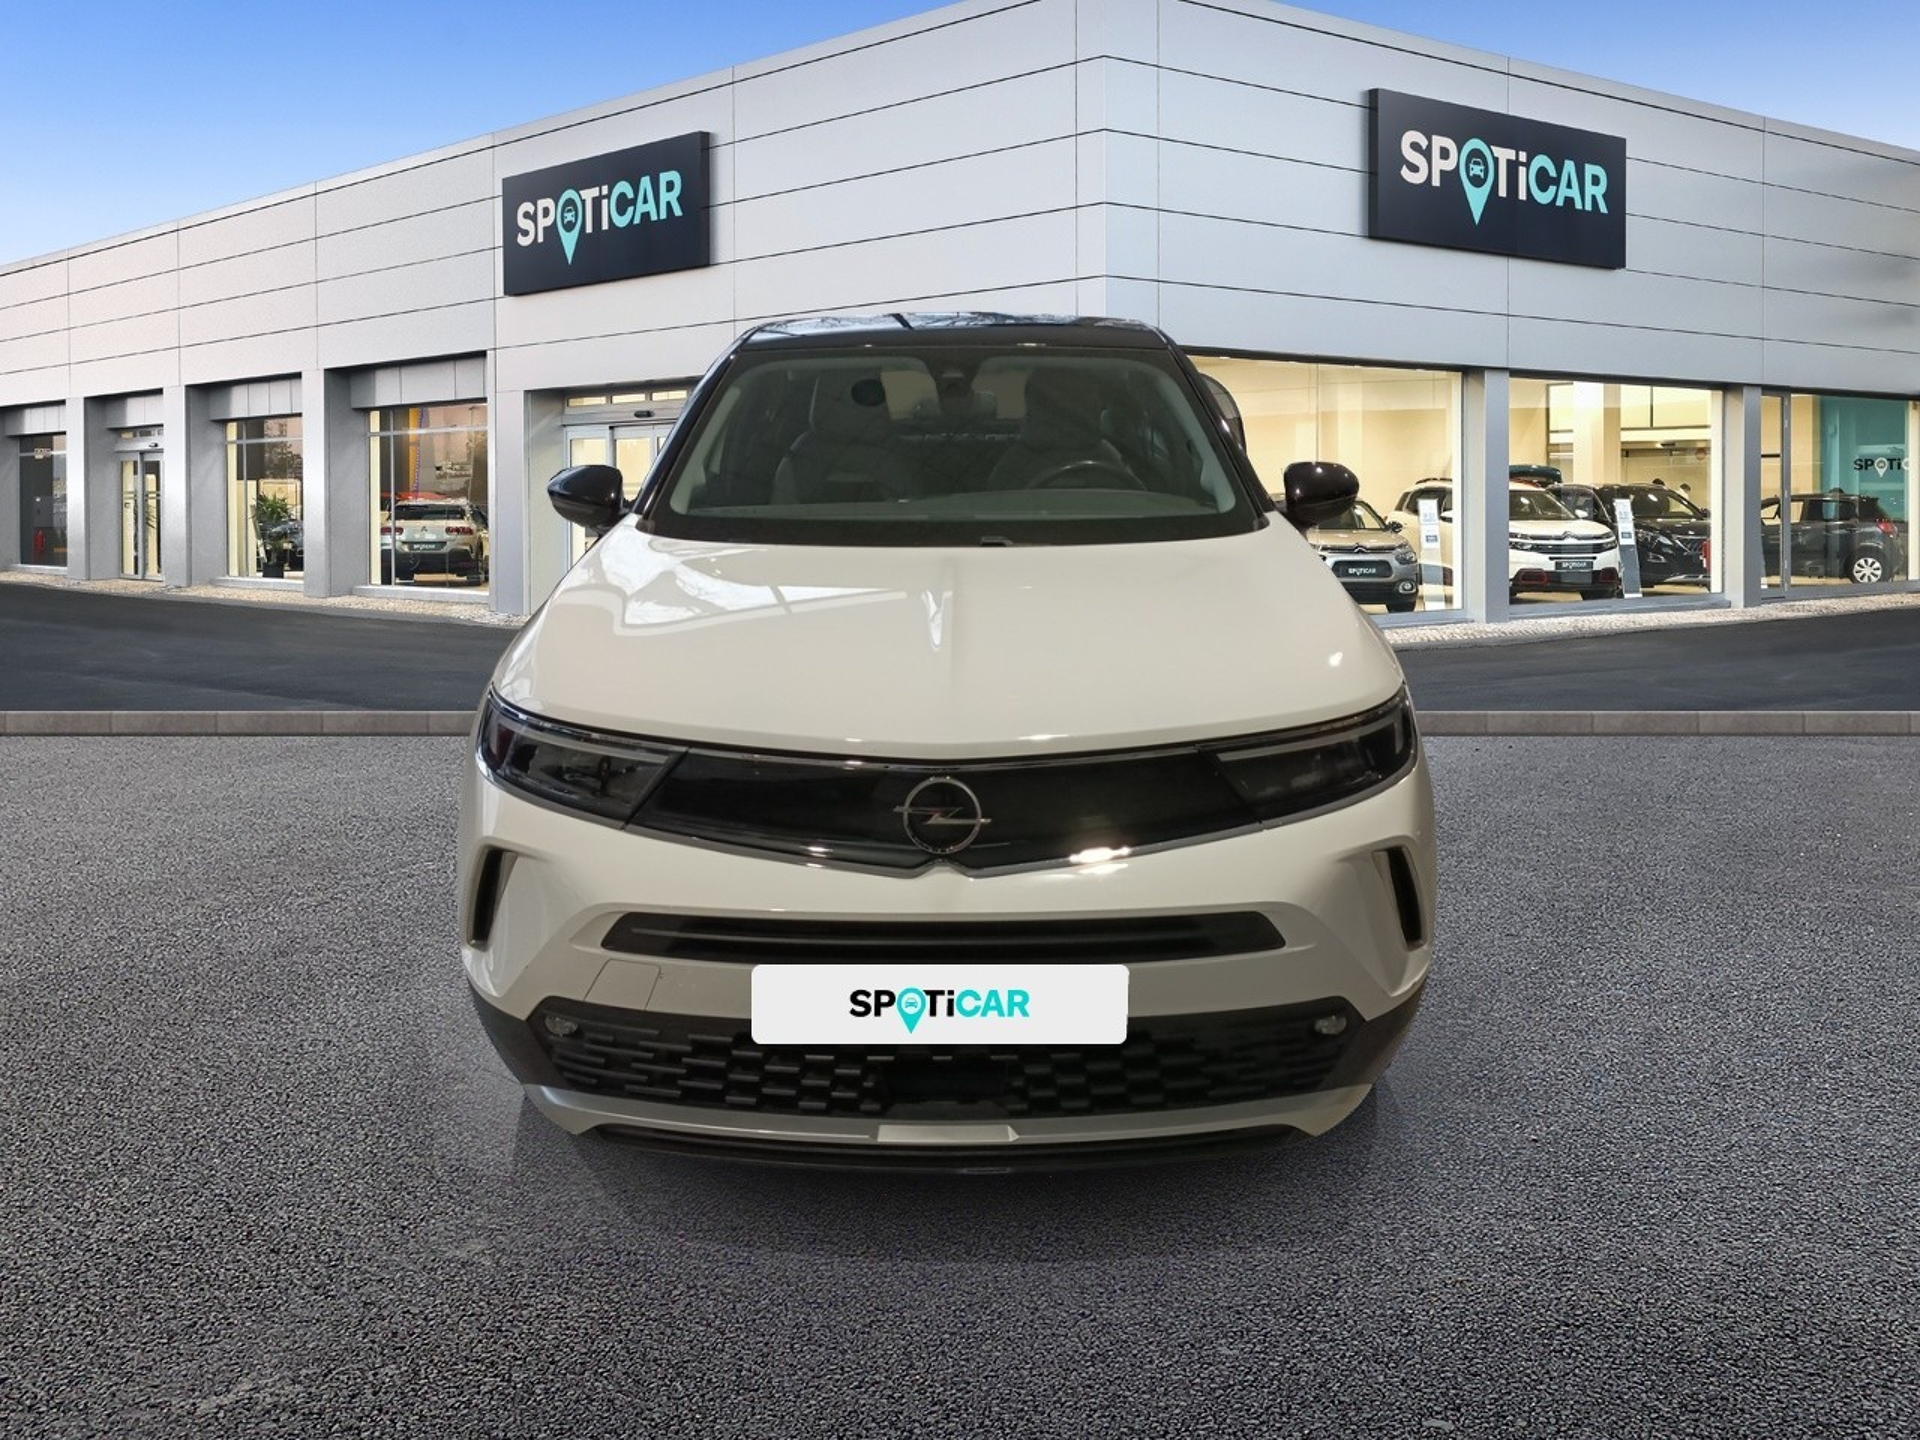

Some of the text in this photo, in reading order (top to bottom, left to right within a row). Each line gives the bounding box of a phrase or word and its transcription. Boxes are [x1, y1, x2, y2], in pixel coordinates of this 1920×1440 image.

[516, 170, 683, 265] SPOTiCAR
[1400, 130, 1609, 226] SPOTiCAR
[849, 987, 1030, 1034] SPOTiCAR
